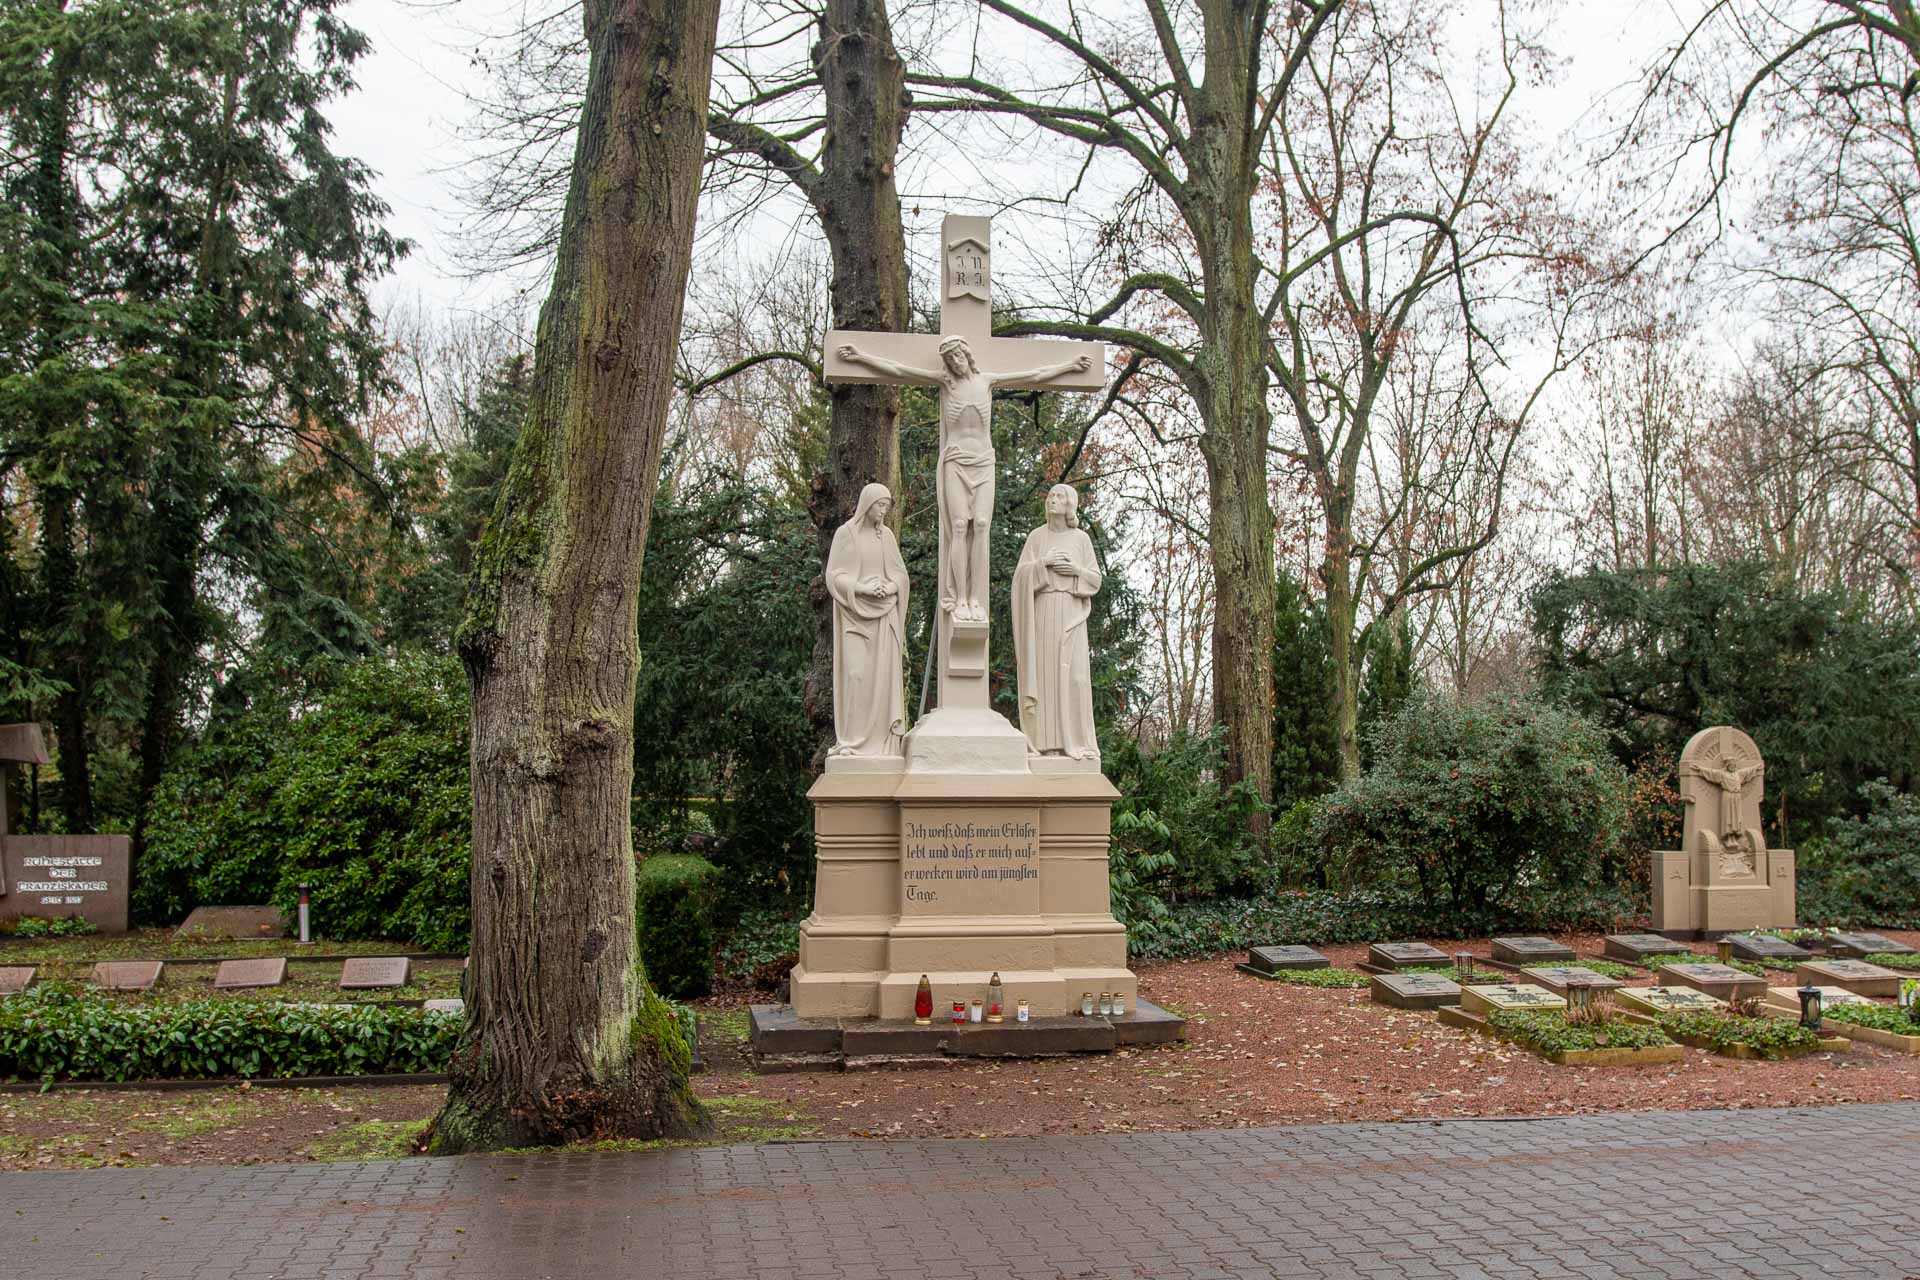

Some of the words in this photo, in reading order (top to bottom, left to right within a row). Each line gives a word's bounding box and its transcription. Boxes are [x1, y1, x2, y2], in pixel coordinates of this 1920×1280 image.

[905, 822, 926, 840] Ich
[954, 822, 974, 840] daß
[976, 825, 1000, 837] mein
[1001, 822, 1036, 838] Erlöser
[906, 844, 926, 858] lebt
[929, 844, 949, 858] und
[951, 843, 974, 861] daß
[975, 848, 987, 858] er
[988, 844, 1012, 860] mich
[904, 865, 953, 880] erwecken
[955, 864, 979, 879] wird
[981, 869, 998, 879] am
[999, 863, 1038, 882] jüngsten
